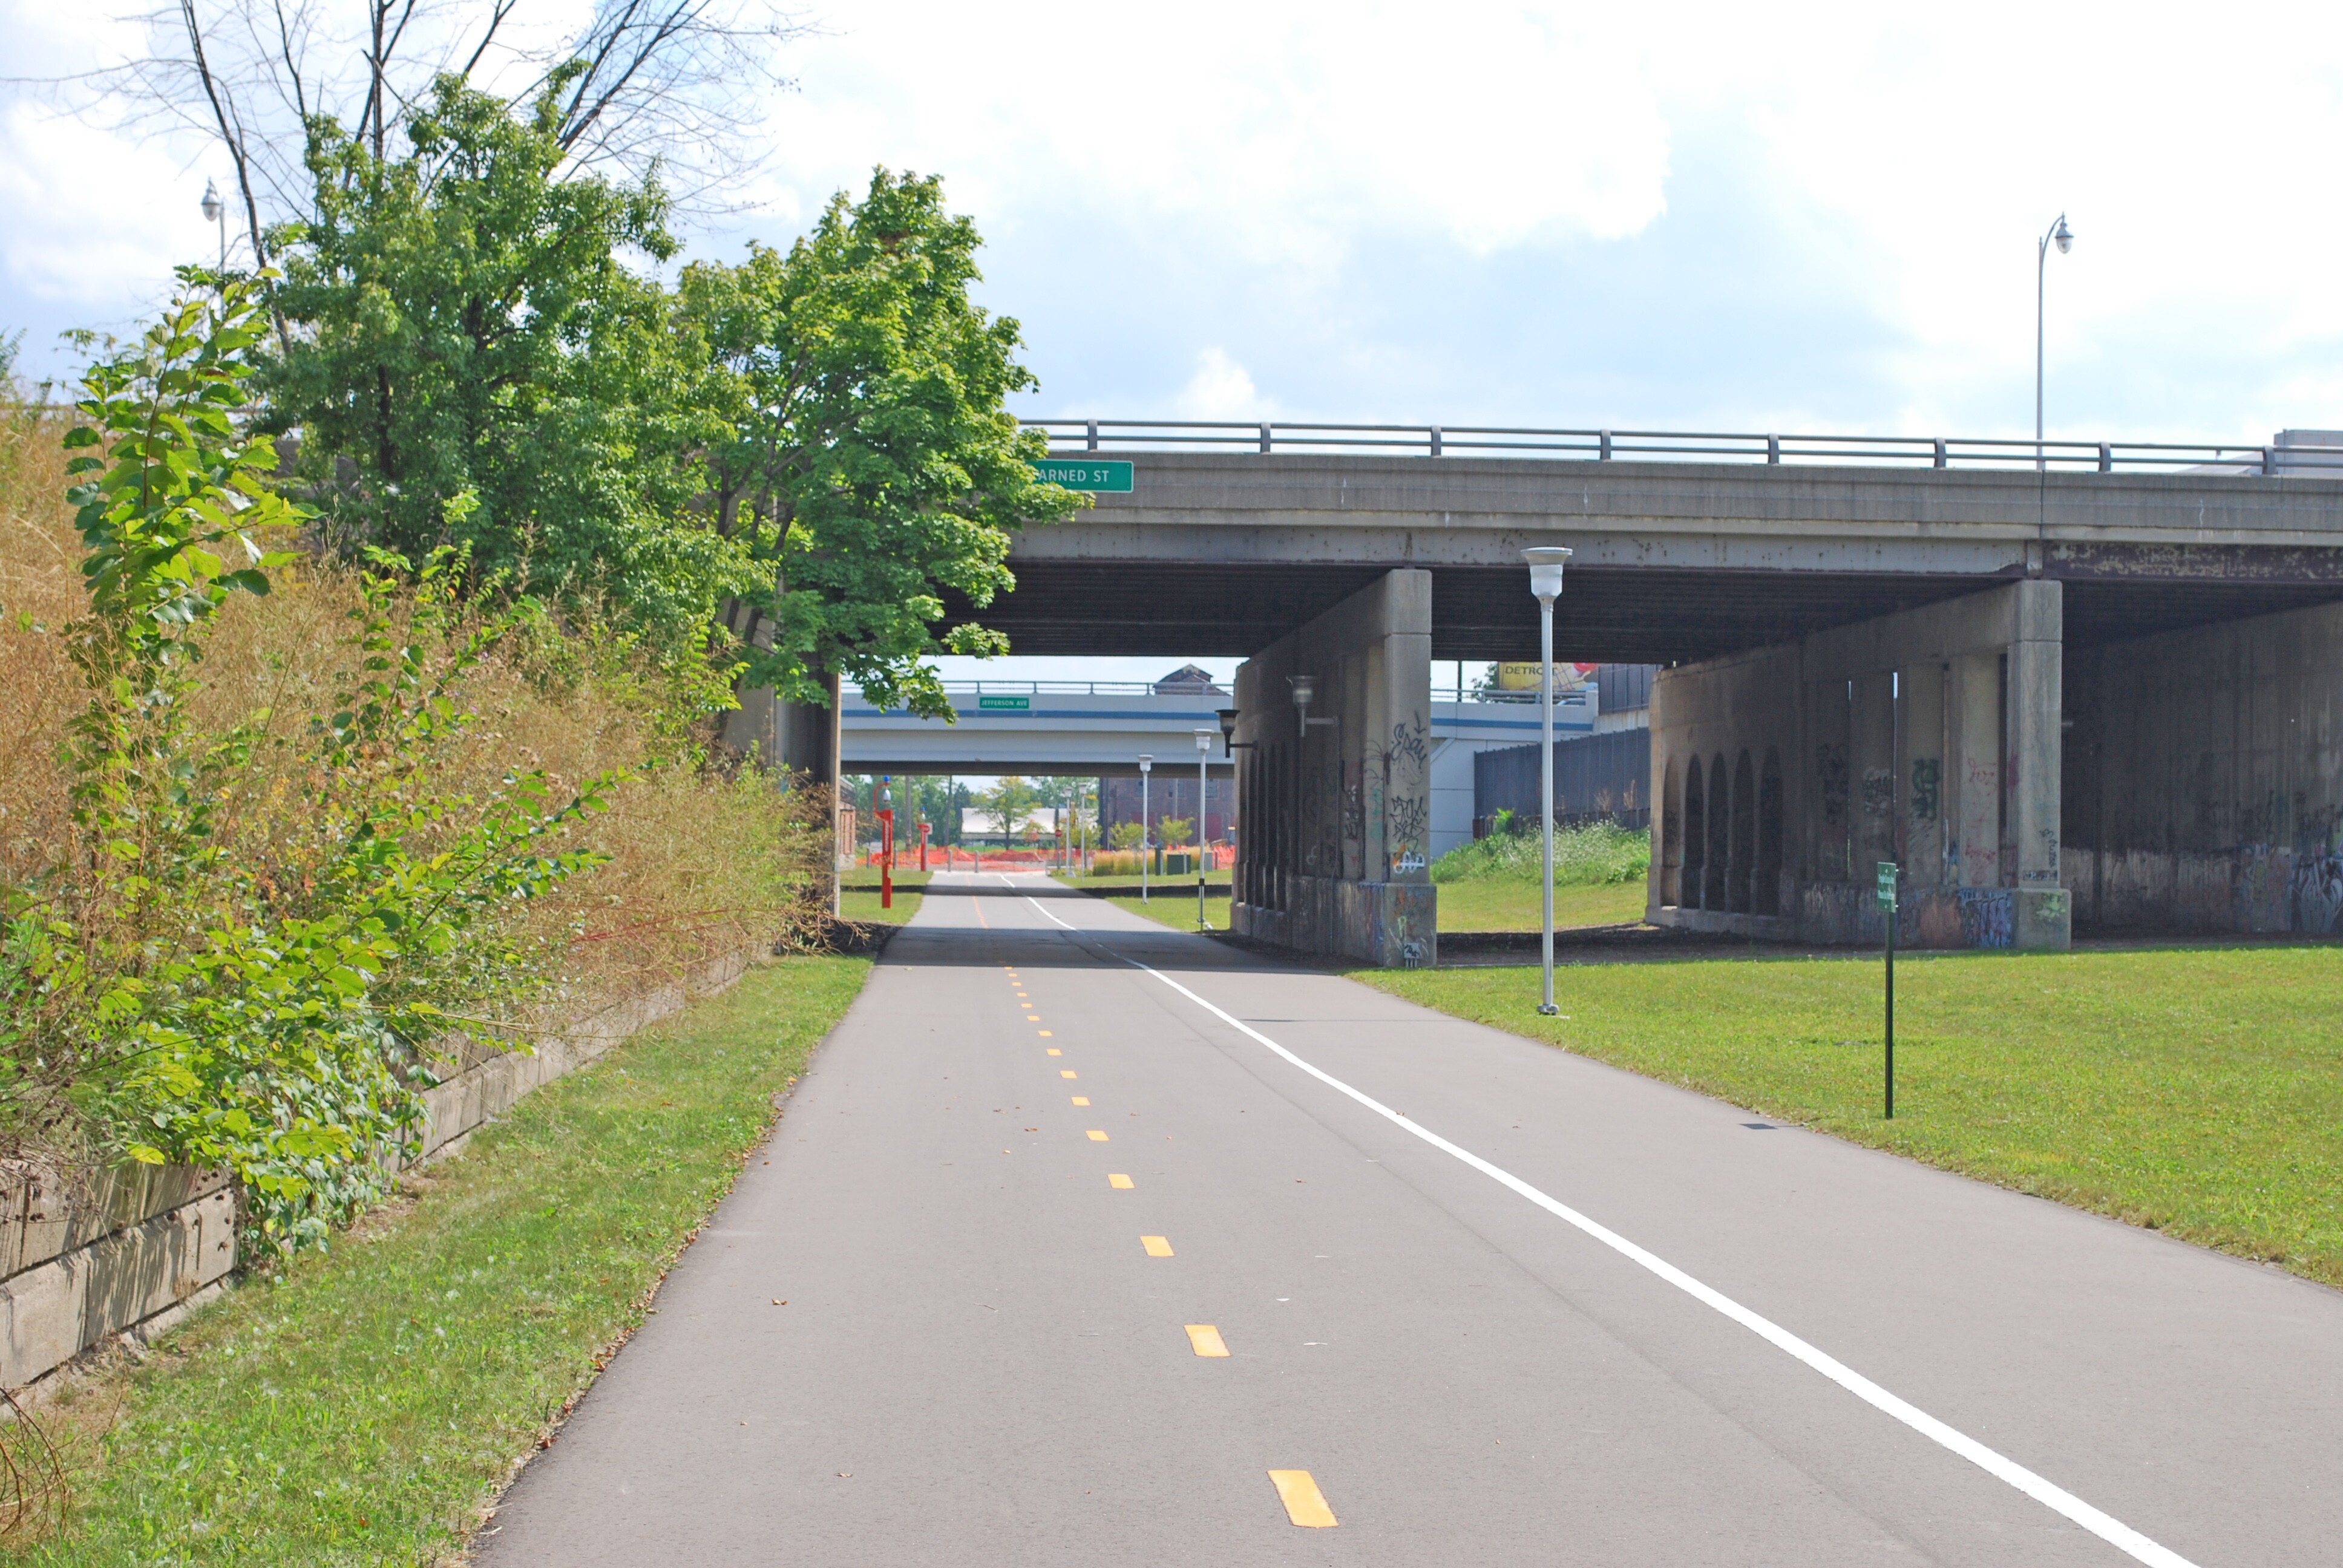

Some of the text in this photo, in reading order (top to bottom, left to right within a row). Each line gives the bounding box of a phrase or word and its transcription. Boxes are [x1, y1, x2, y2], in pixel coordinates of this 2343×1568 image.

[1034, 469, 1110, 482] ARNED ST
[1505, 666, 1558, 676] DETROT
